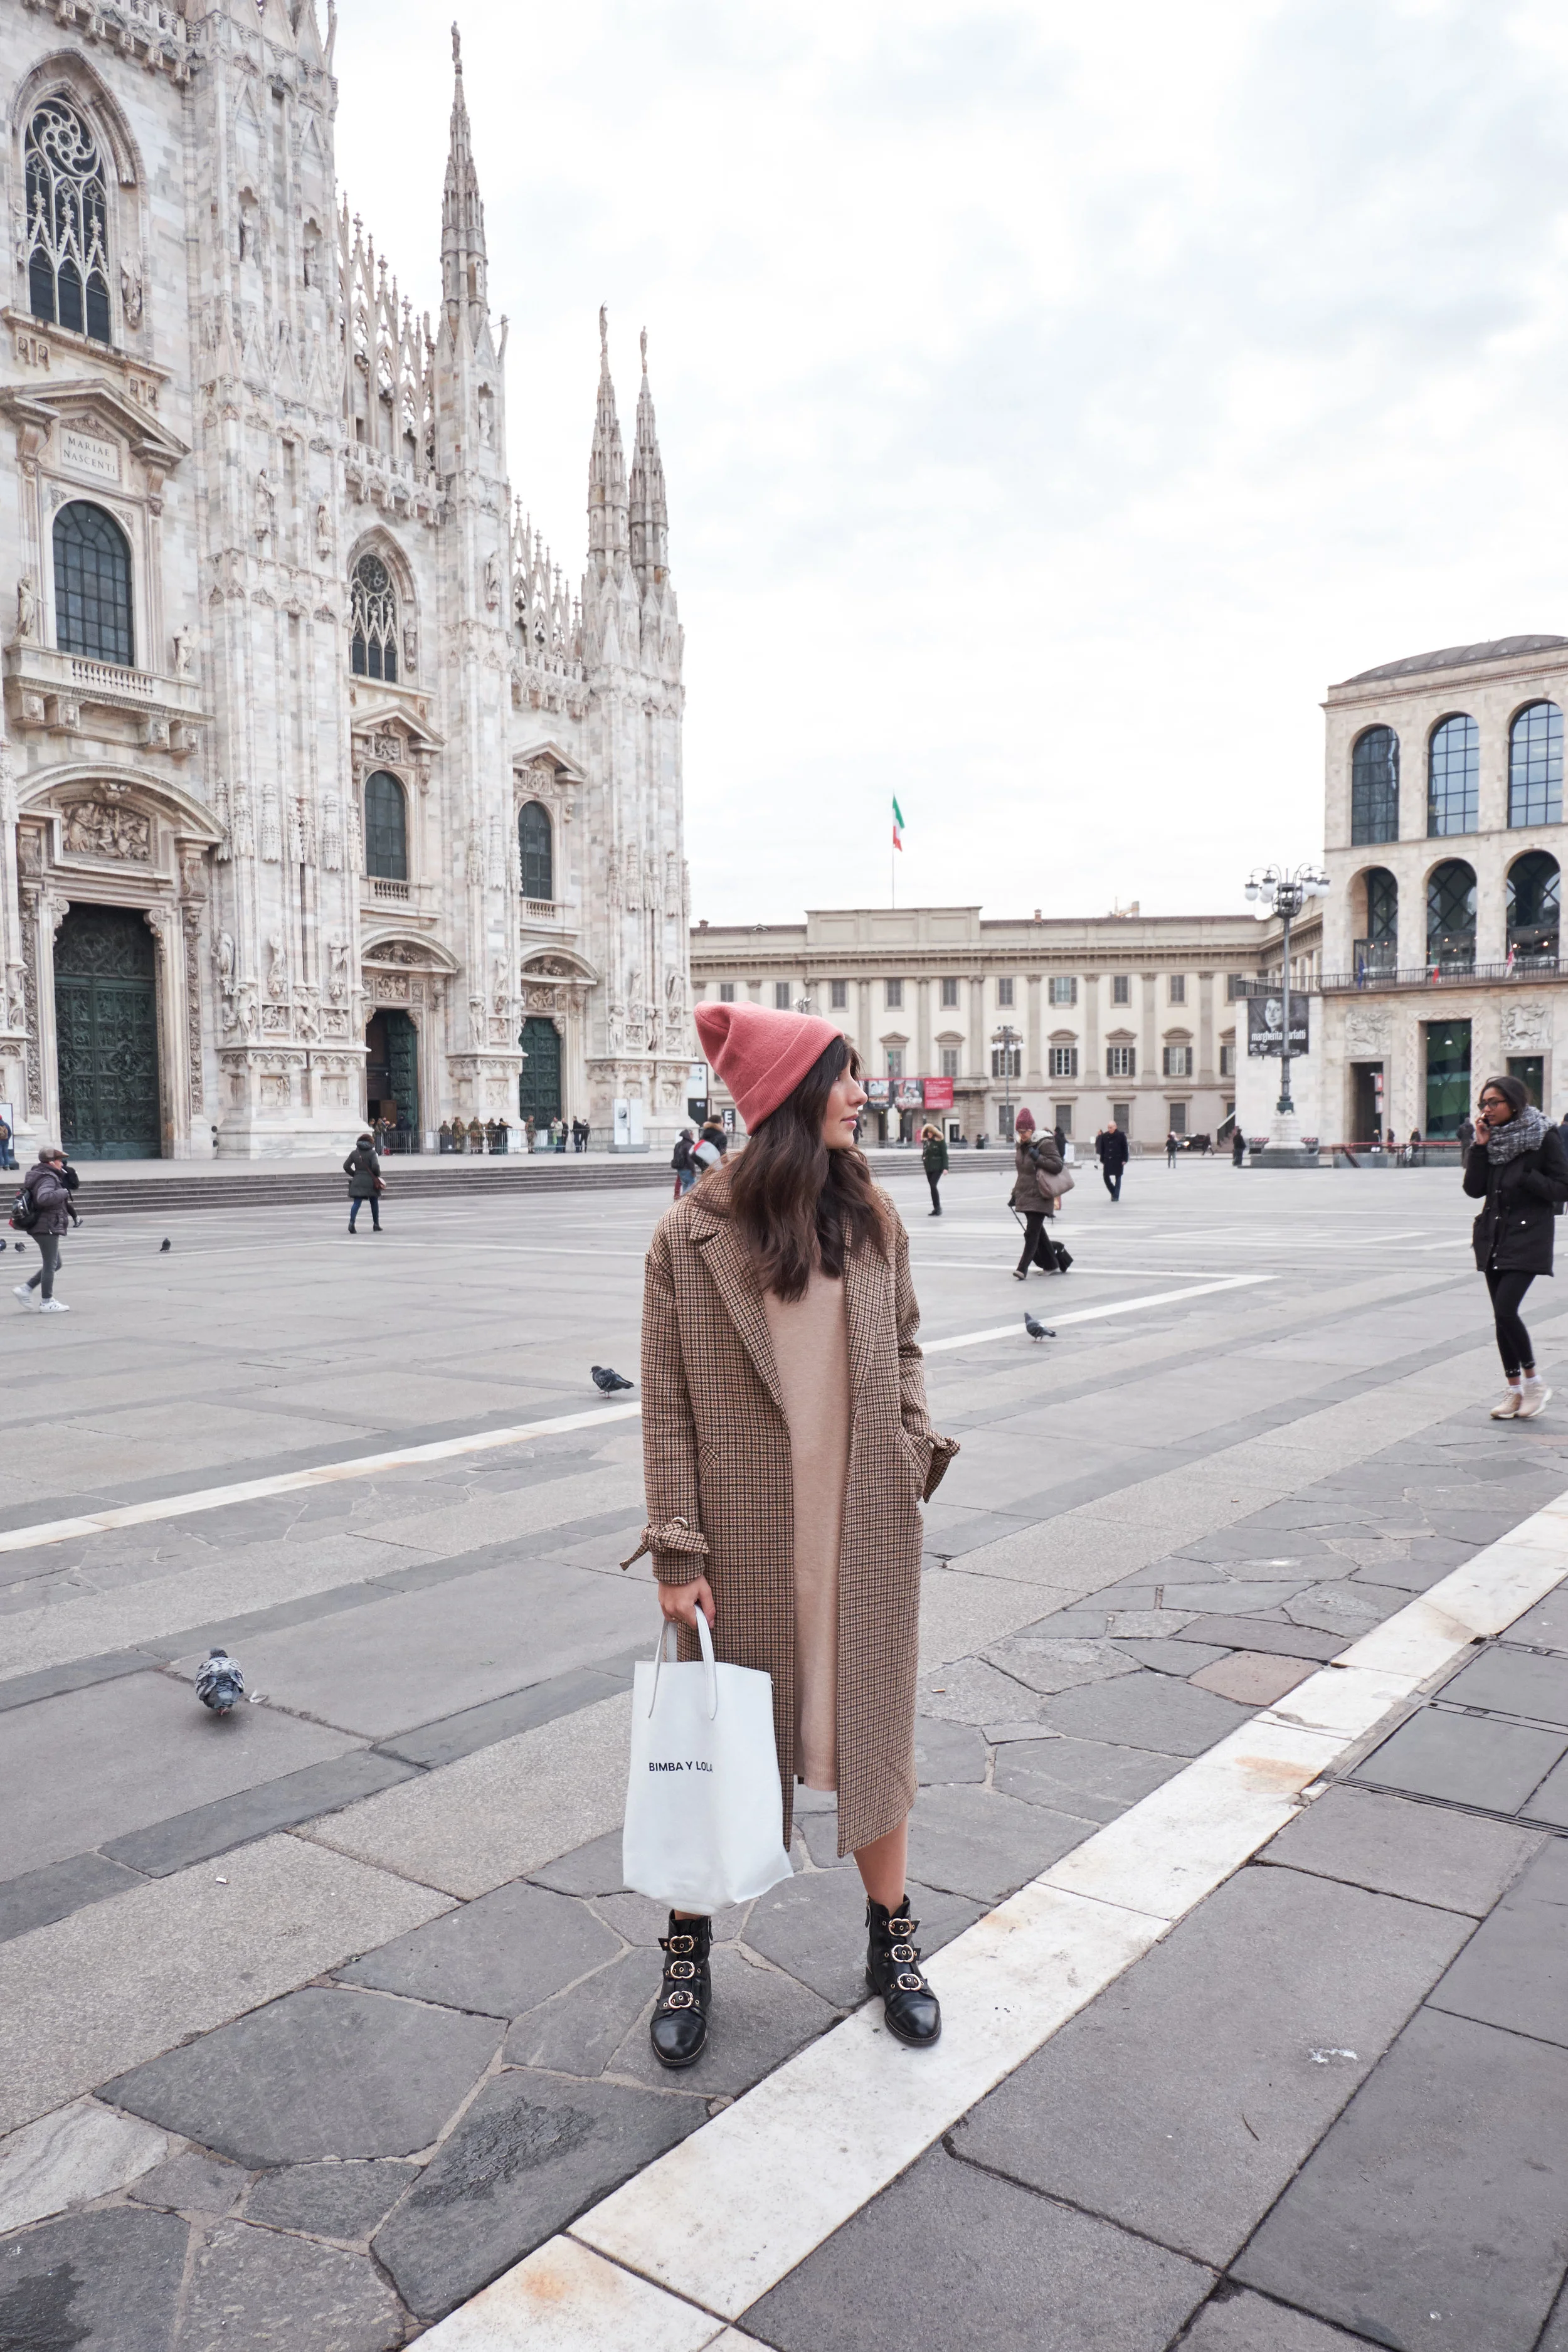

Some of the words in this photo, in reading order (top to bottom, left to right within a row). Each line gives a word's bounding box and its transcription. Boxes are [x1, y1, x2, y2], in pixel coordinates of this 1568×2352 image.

[68, 436, 110, 457] MARIAE
[64, 449, 115, 473] NASCENTI
[1251, 1030, 1283, 1043] margherita
[1289, 1029, 1306, 1039] rfatti
[649, 1762, 683, 1772] BIMBA
[685, 1761, 692, 1771] Y
[696, 1761, 713, 1773] LOLA
